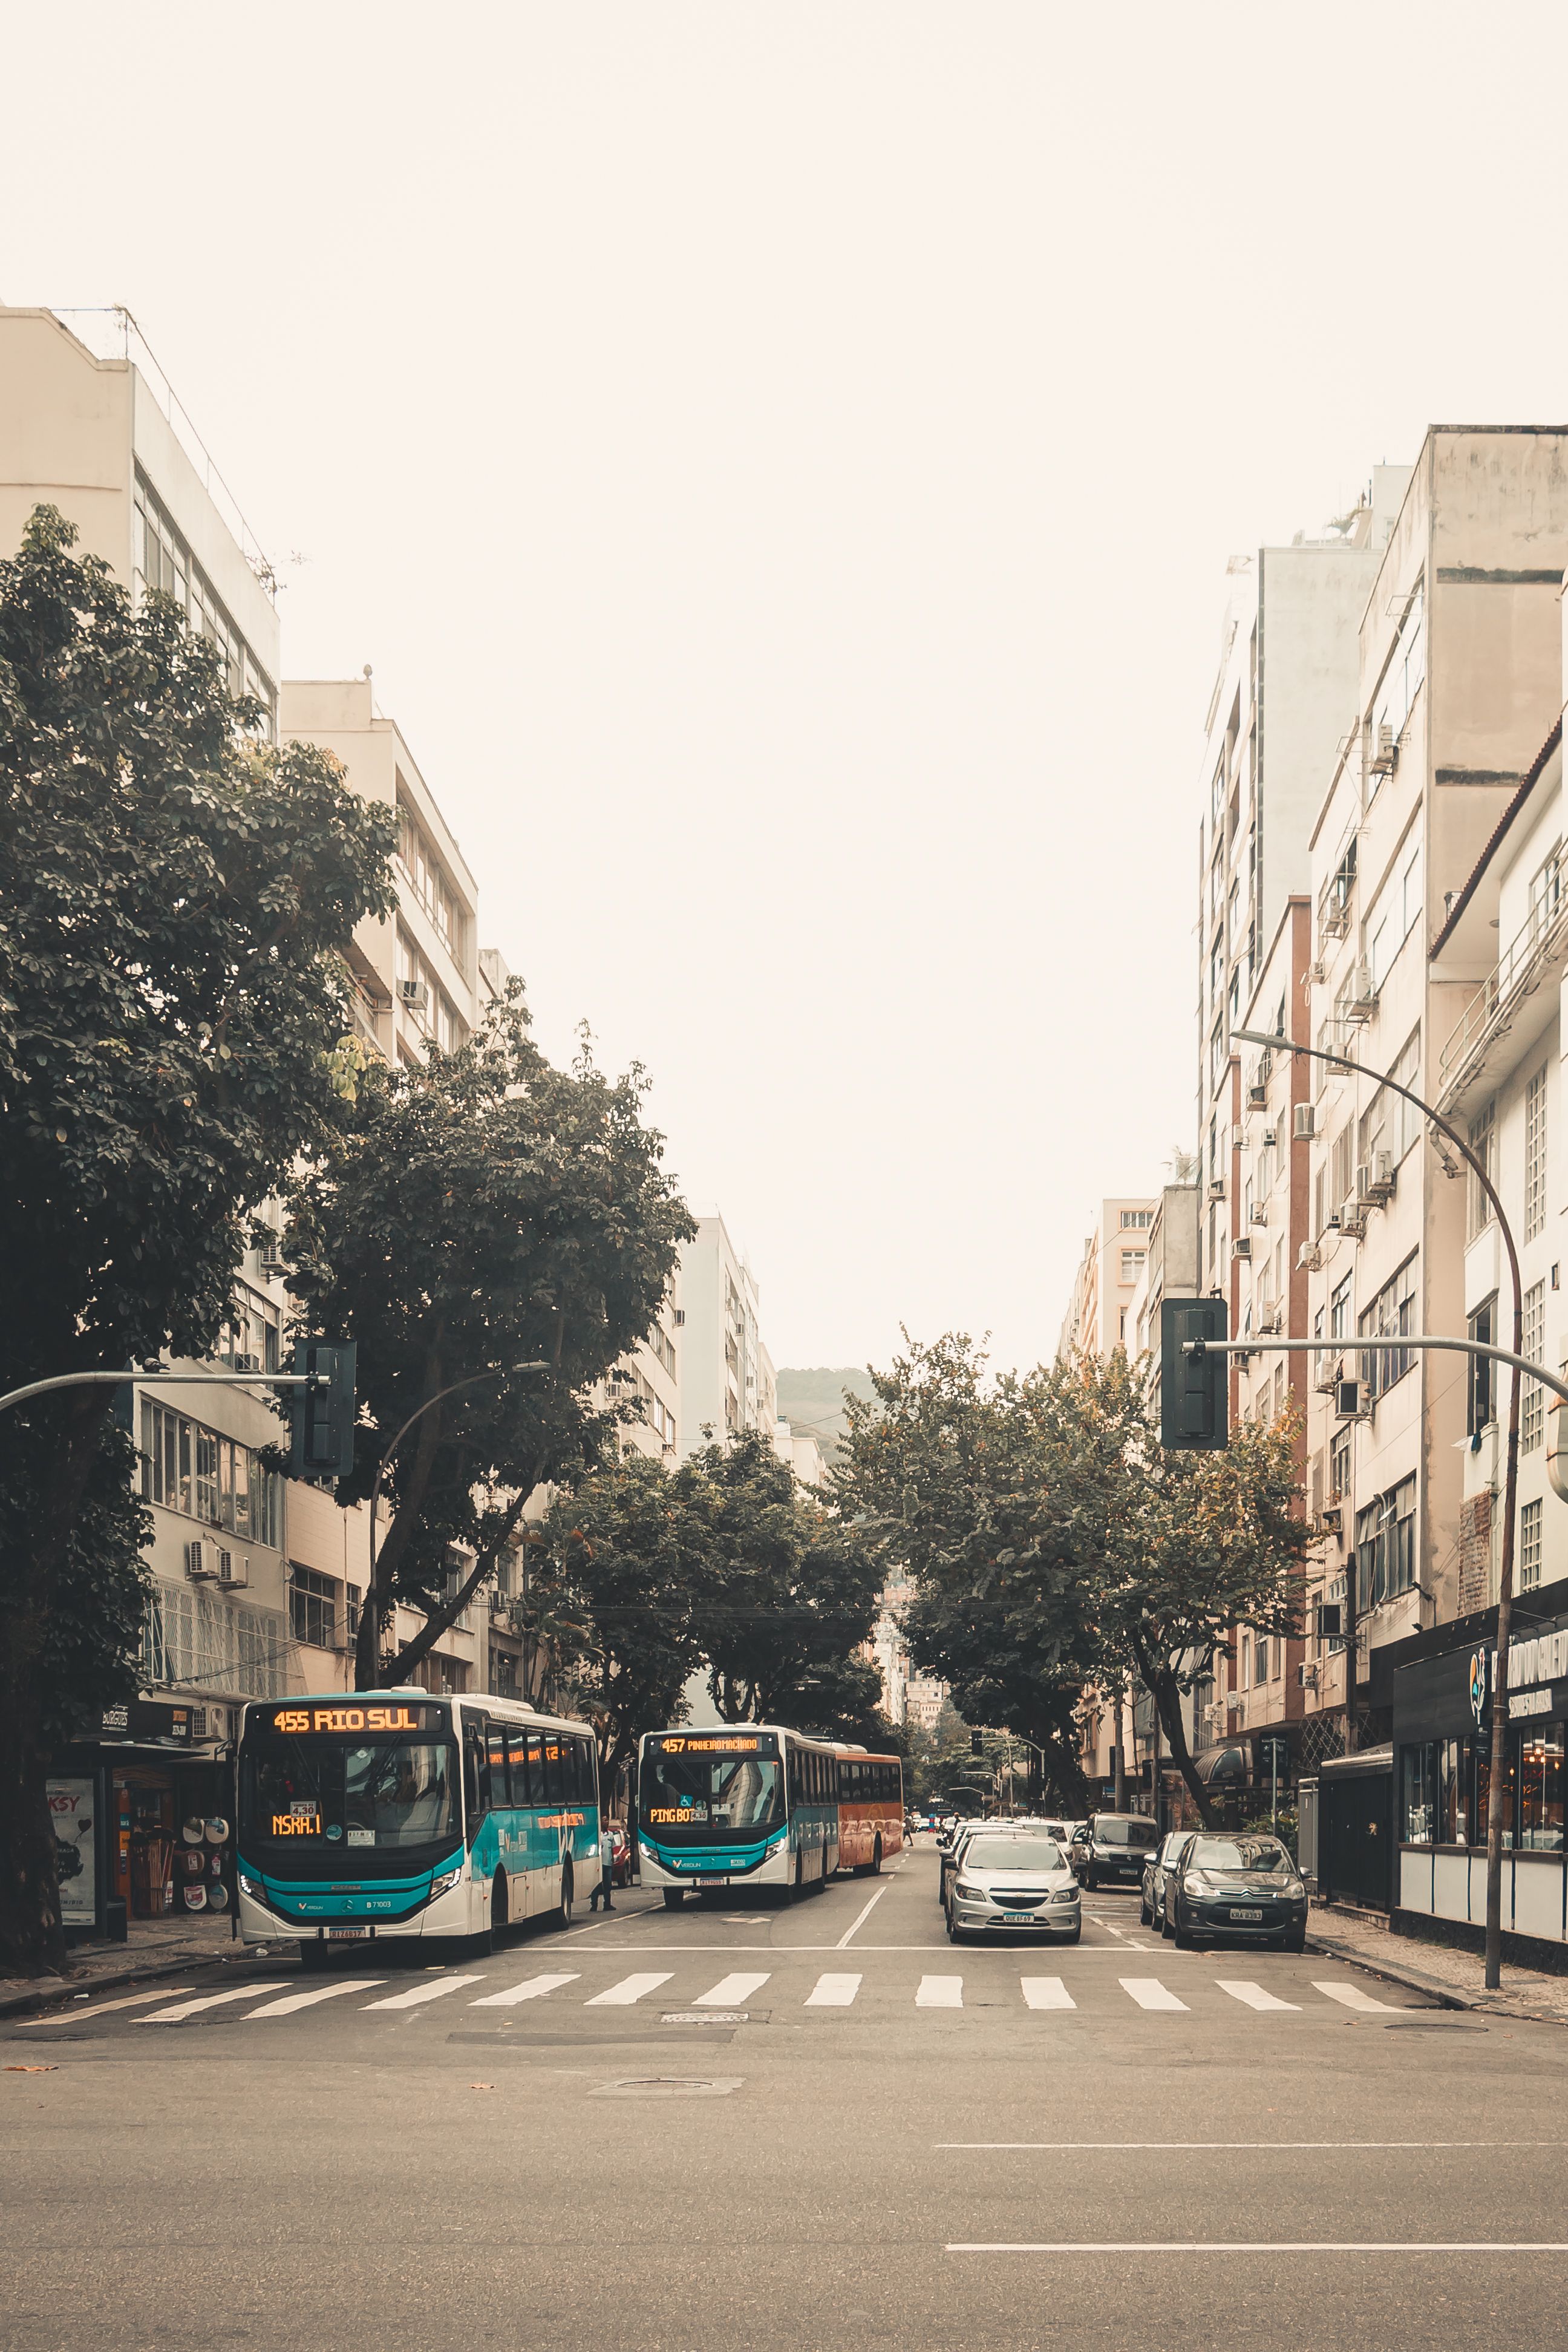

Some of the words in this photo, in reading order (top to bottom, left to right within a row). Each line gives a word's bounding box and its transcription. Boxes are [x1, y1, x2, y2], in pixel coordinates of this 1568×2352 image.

[274, 1711, 309, 1731] 455
[315, 1710, 364, 1731] RIO
[367, 1708, 417, 1730] SUL
[662, 1739, 685, 1753] 457
[292, 1807, 314, 1816] 4,30
